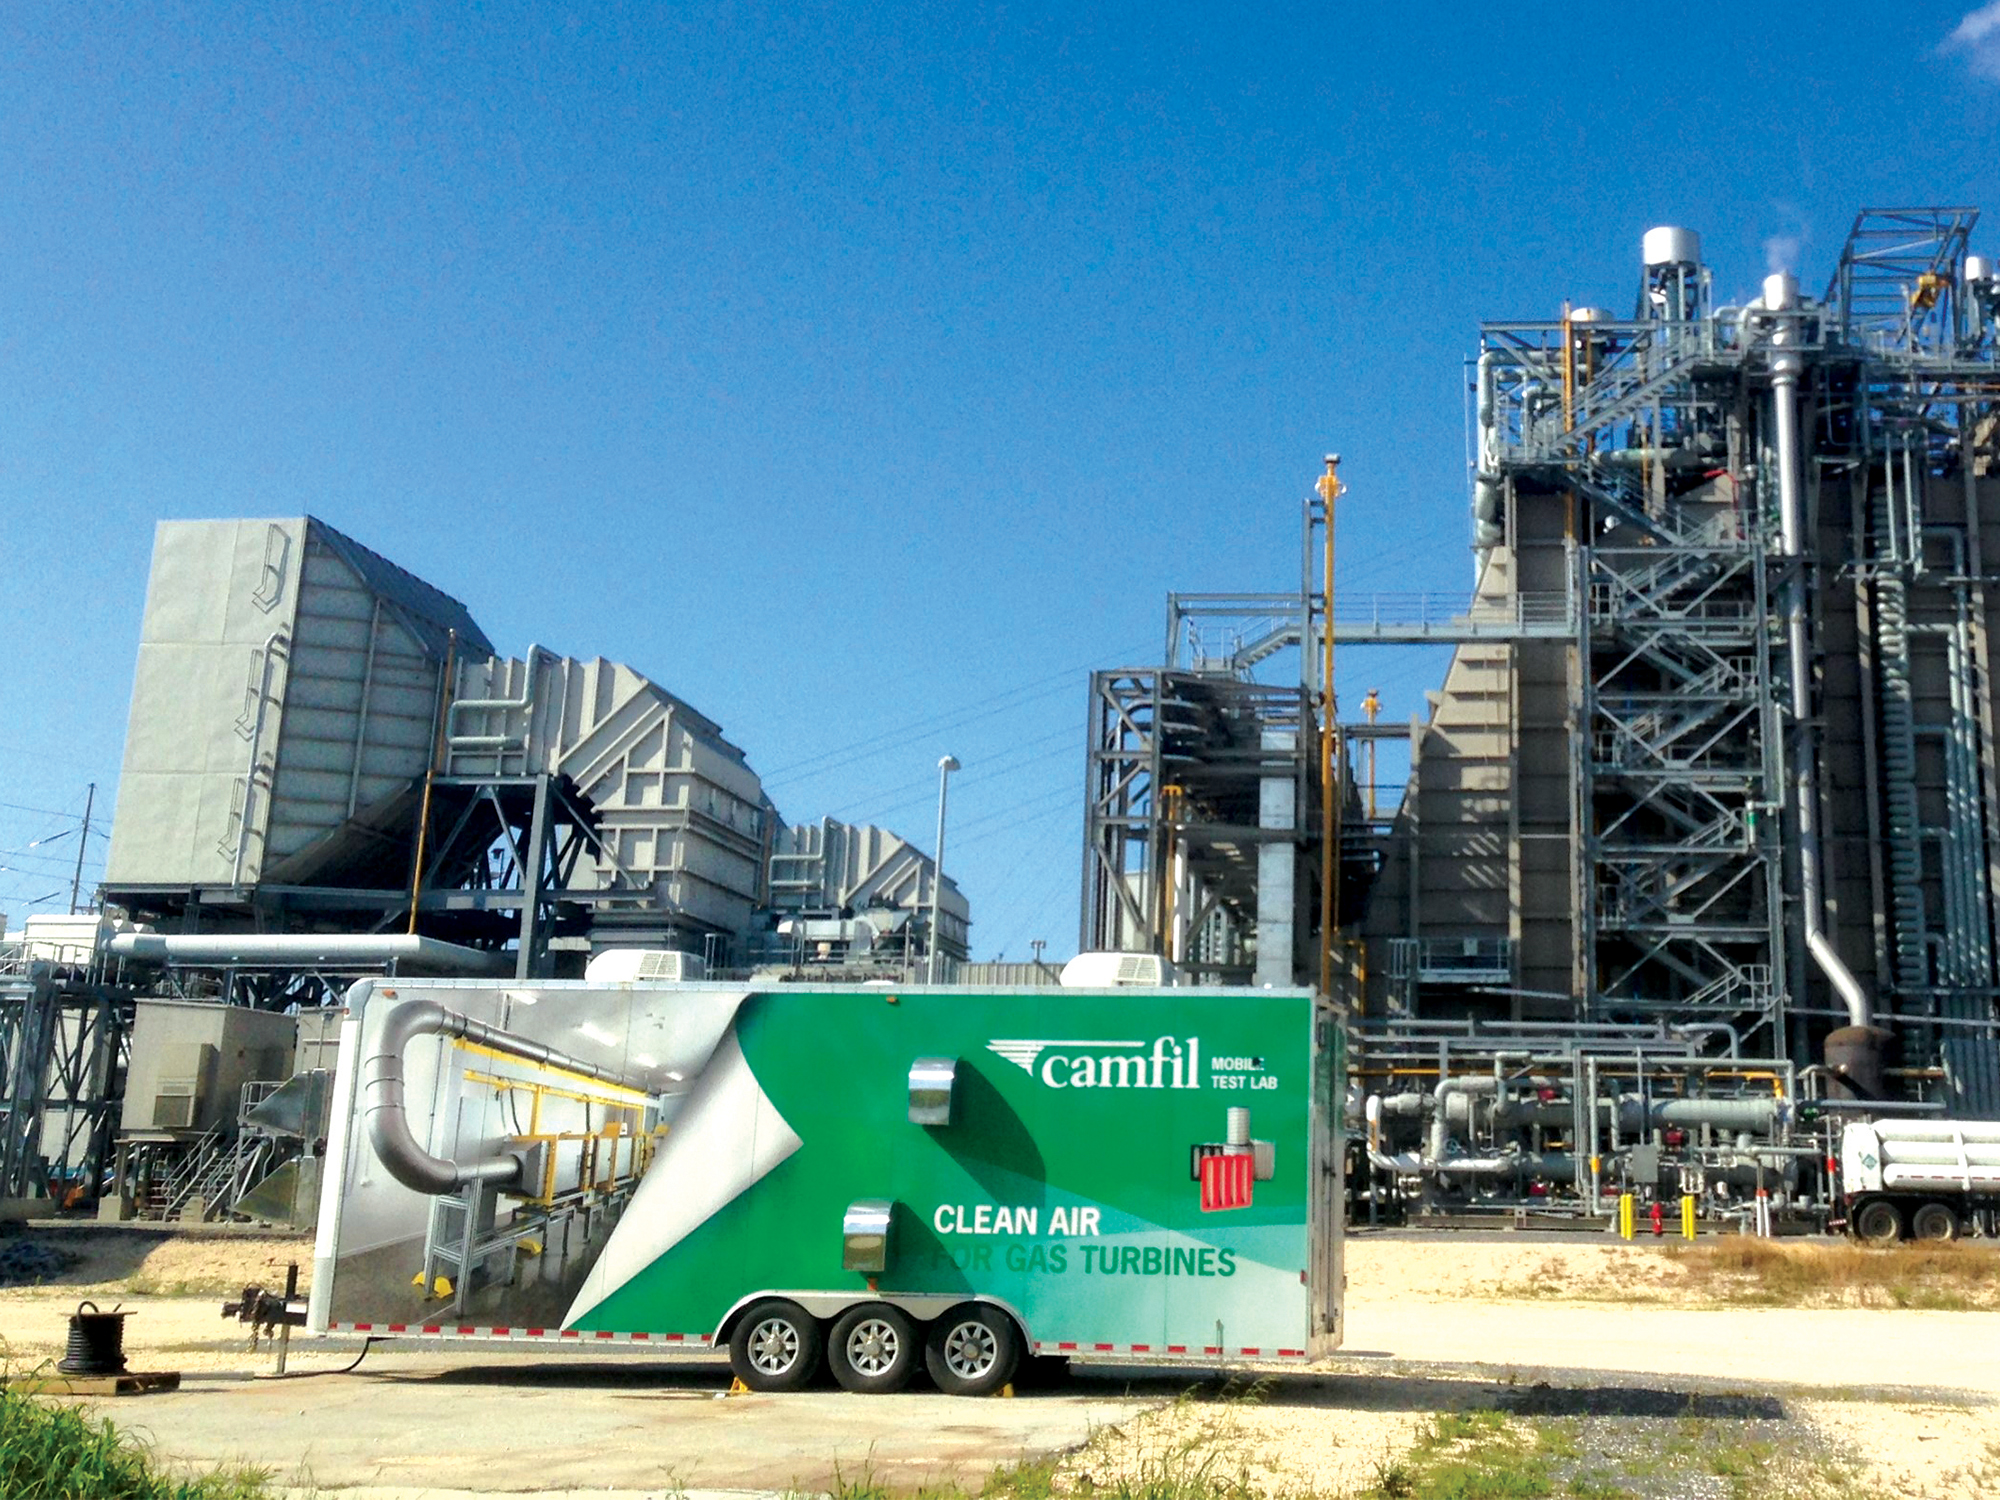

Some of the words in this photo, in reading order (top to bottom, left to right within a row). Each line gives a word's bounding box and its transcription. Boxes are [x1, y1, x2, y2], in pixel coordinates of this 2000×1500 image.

[1042, 1036, 1200, 1088] camfil
[1211, 1076, 1246, 1089] TEST
[1250, 1076, 1278, 1090] LAB
[934, 1204, 1037, 1234] CLEAN
[1048, 1206, 1100, 1236] AIR
[931, 1243, 992, 1272] FOR
[1005, 1244, 1068, 1273] GAS
[1079, 1245, 1236, 1276] TURBINES
